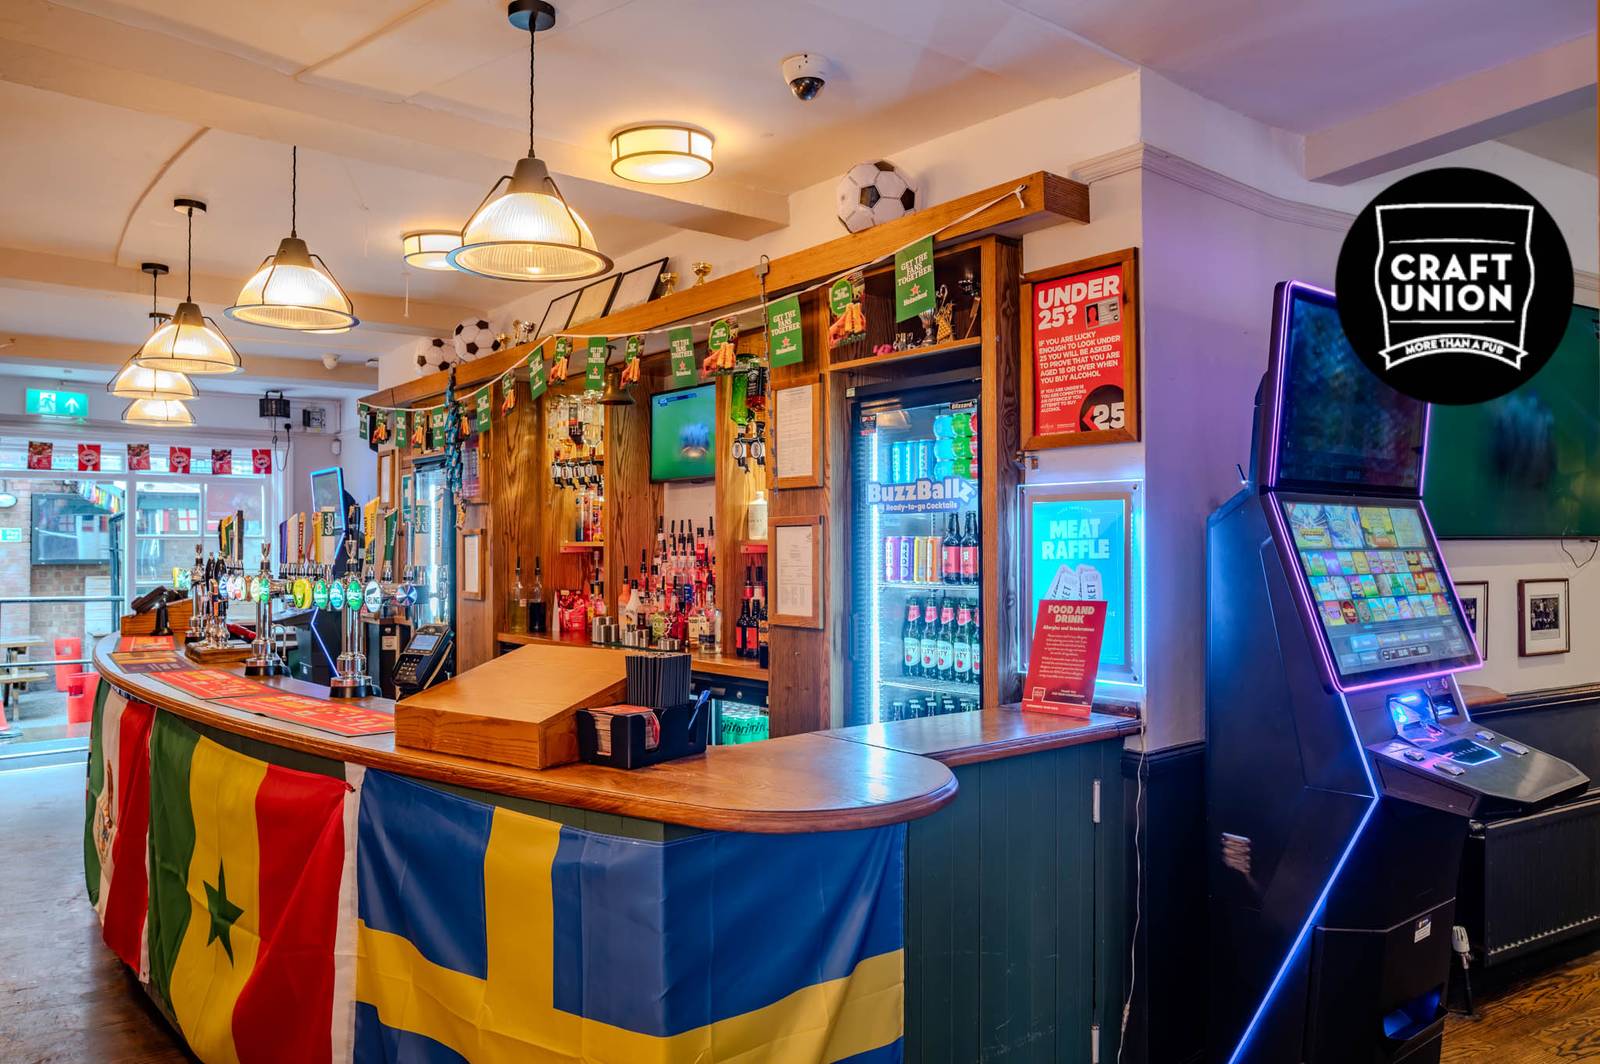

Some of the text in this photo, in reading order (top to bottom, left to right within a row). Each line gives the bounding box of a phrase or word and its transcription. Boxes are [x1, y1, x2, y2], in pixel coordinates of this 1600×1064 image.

[901, 251, 928, 271] GET THE
[907, 262, 923, 277] FANS
[898, 264, 932, 286] TOGETHER
[1038, 275, 1120, 309] UNDER
[1038, 304, 1077, 331] 25?
[1039, 335, 1121, 354] ENOUGH TO LOOK UNDER
[1045, 337, 1060, 345] YOU
[1060, 335, 1073, 343] ARE
[1074, 331, 1096, 341] LUCKY
[1048, 352, 1062, 361] YOU
[1062, 350, 1079, 358] WILL
[1089, 344, 1113, 354] ASKED
[1049, 358, 1072, 368] PROVE
[1072, 355, 1089, 363] THAT
[1090, 352, 1105, 361] YOU
[1105, 351, 1120, 359] ARE
[1040, 359, 1119, 377] AGED 18 OR OVER WHEN
[1040, 376, 1054, 385] YOU
[1054, 374, 1069, 383] BUY
[868, 478, 976, 503] BuzzBallz
[886, 500, 958, 512] Ready-to-go Cocktails
[1049, 518, 1100, 539] MEAT
[1041, 538, 1110, 560] RAFFLE
[1047, 604, 1074, 615] FOOD
[1074, 605, 1095, 616] AND
[1054, 614, 1085, 624] DRINK
